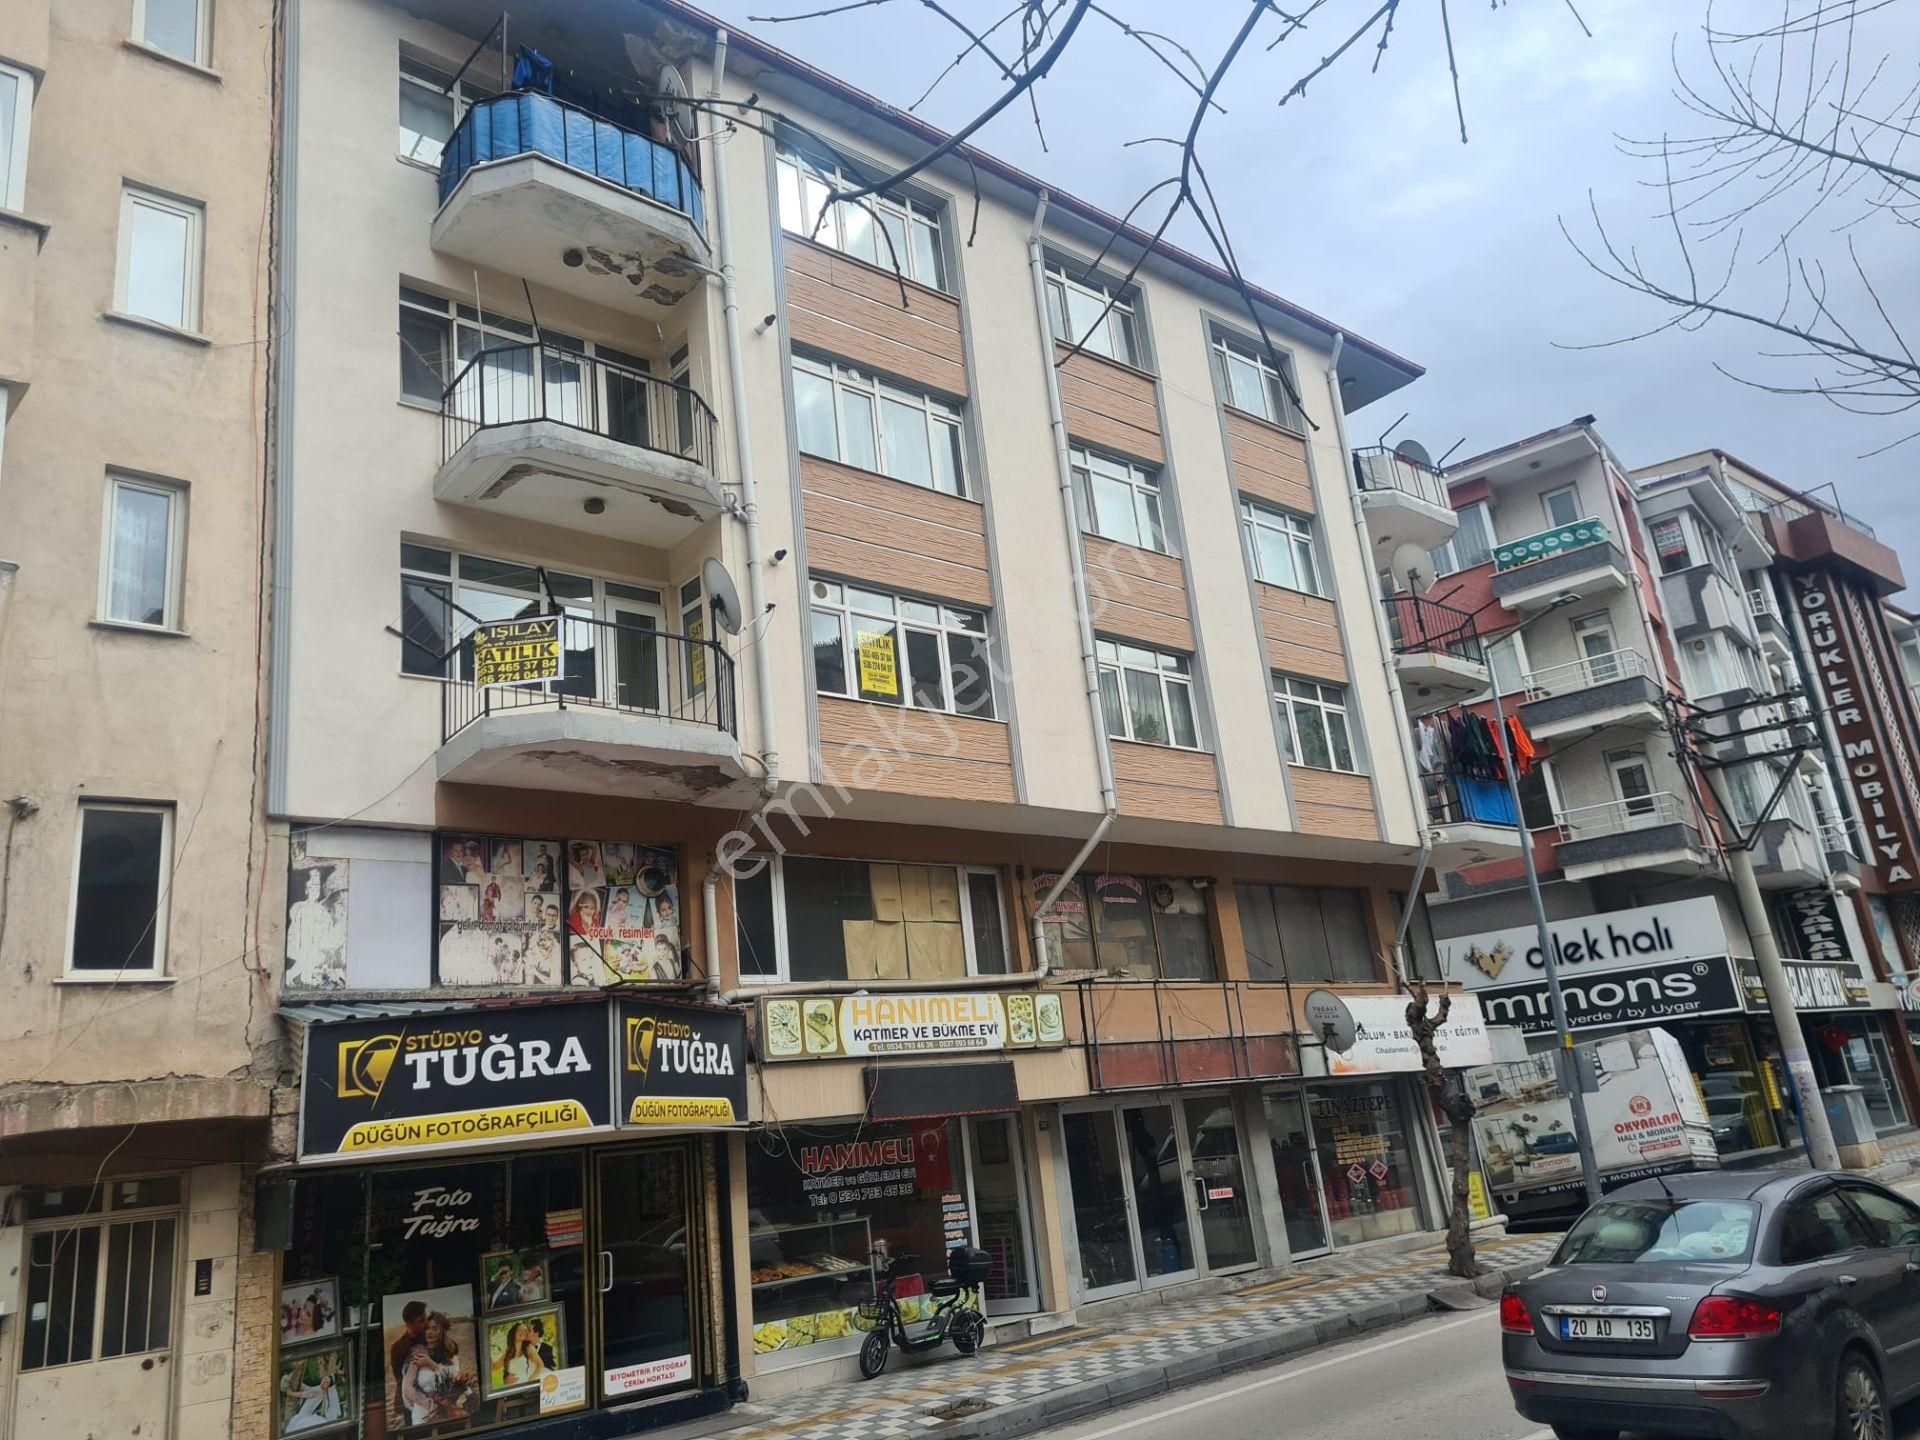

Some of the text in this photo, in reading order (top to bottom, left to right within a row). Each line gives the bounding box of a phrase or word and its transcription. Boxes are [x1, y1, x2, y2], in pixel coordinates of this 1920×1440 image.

[498, 662, 520, 674] 465
[523, 660, 538, 670] 37
[541, 667, 557, 678] 97
[1796, 572, 1912, 884] YÖRÜKLER MOBİLYA
[618, 925, 655, 939] resimleri
[1607, 917, 1674, 957] halı
[1481, 972, 1698, 1023] mmons
[1568, 1011, 1613, 1027] yerde
[1627, 1006, 1647, 1020] by
[1651, 1000, 1701, 1017] Uygar
[406, 1029, 483, 1052] STÜDYO
[657, 1020, 690, 1038] STÜDYO
[853, 1027, 909, 1042] KATMER
[912, 1026, 929, 1039] VE
[932, 1023, 976, 1038] BÜKME
[1358, 1032, 1386, 1041] DOLUM
[1394, 1029, 1414, 1040] BAKI
[405, 1033, 592, 1090] TUĞRA
[657, 1031, 734, 1075] TUĞRA
[635, 1100, 730, 1118] DÜĞÜN FOTOĞRAFÇILIĞI
[353, 1104, 578, 1146] DÜĞÜN FOTOĞRAFÇILIĞI
[412, 1186, 472, 1212] Foto
[403, 1214, 480, 1240] Tuğra
[1571, 1320, 1587, 1336] 20
[1596, 1320, 1612, 1336] AD
[1626, 1319, 1652, 1337] 135
